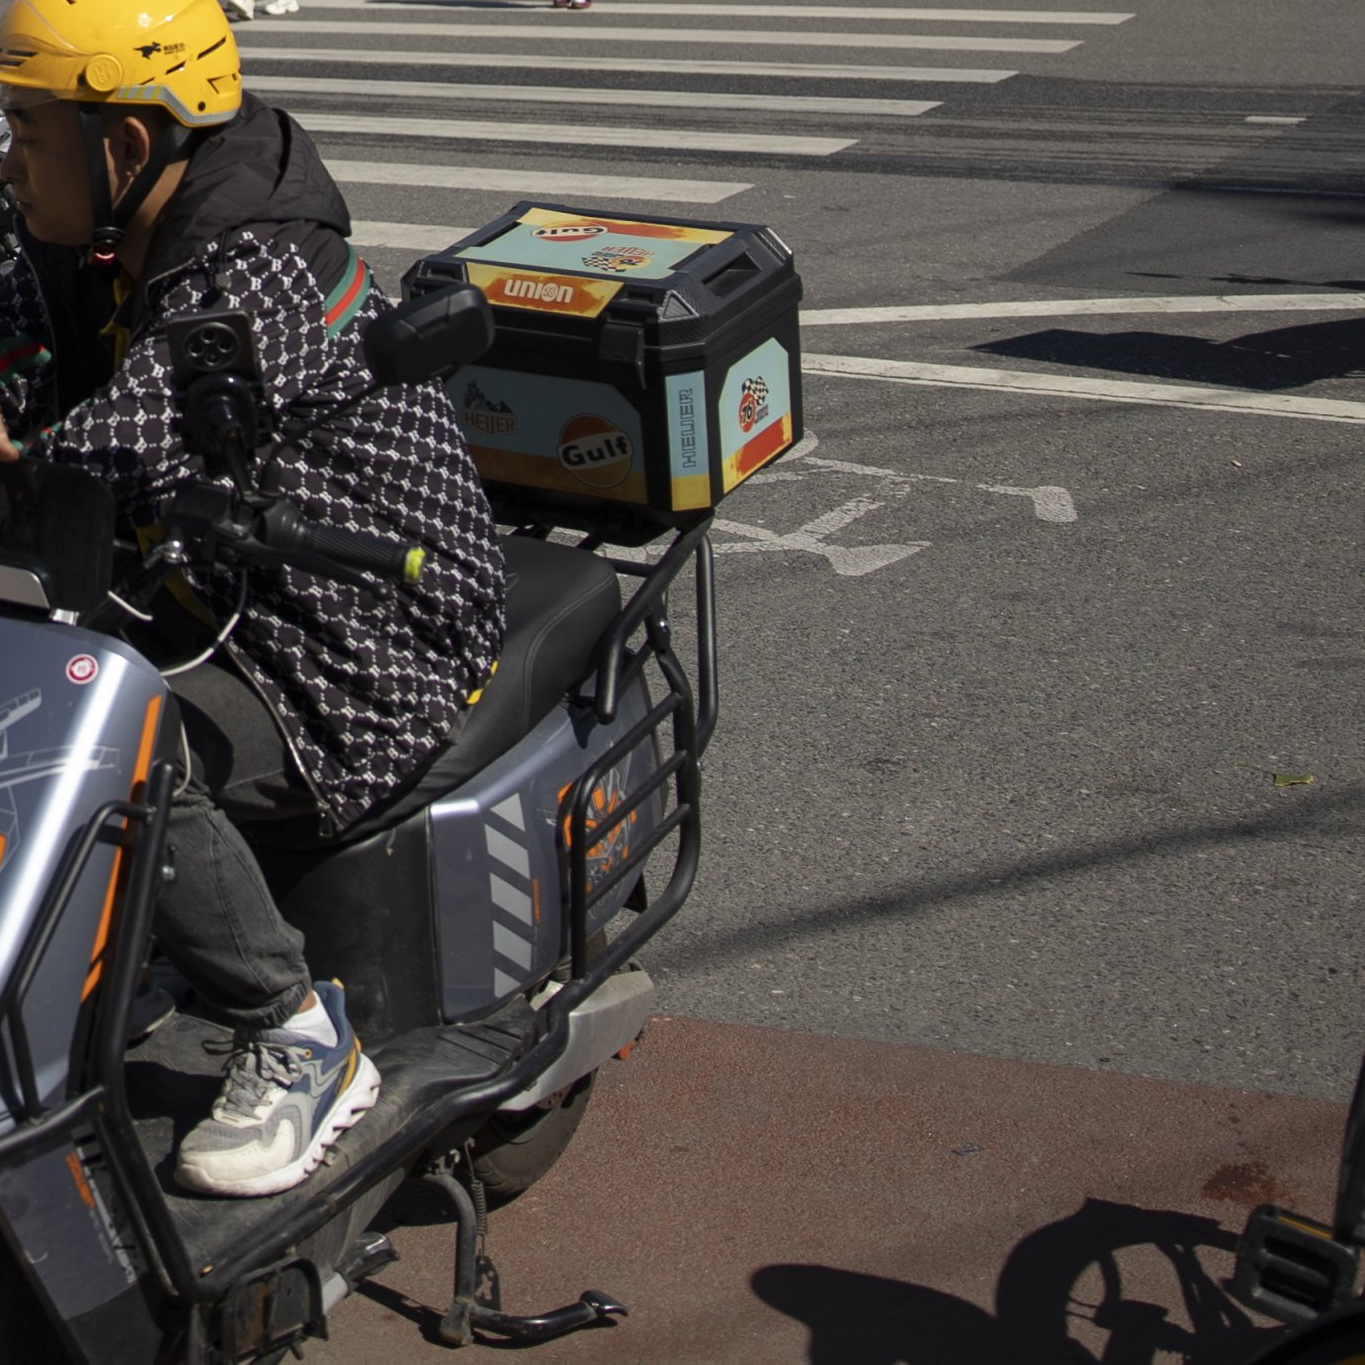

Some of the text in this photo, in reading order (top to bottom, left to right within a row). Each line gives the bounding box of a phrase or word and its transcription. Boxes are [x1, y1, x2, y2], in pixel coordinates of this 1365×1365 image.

[535, 226, 605, 237] Gulf
[463, 411, 517, 435] HEUER
[677, 388, 697, 469] HEUER
[561, 435, 629, 467] Gulf
